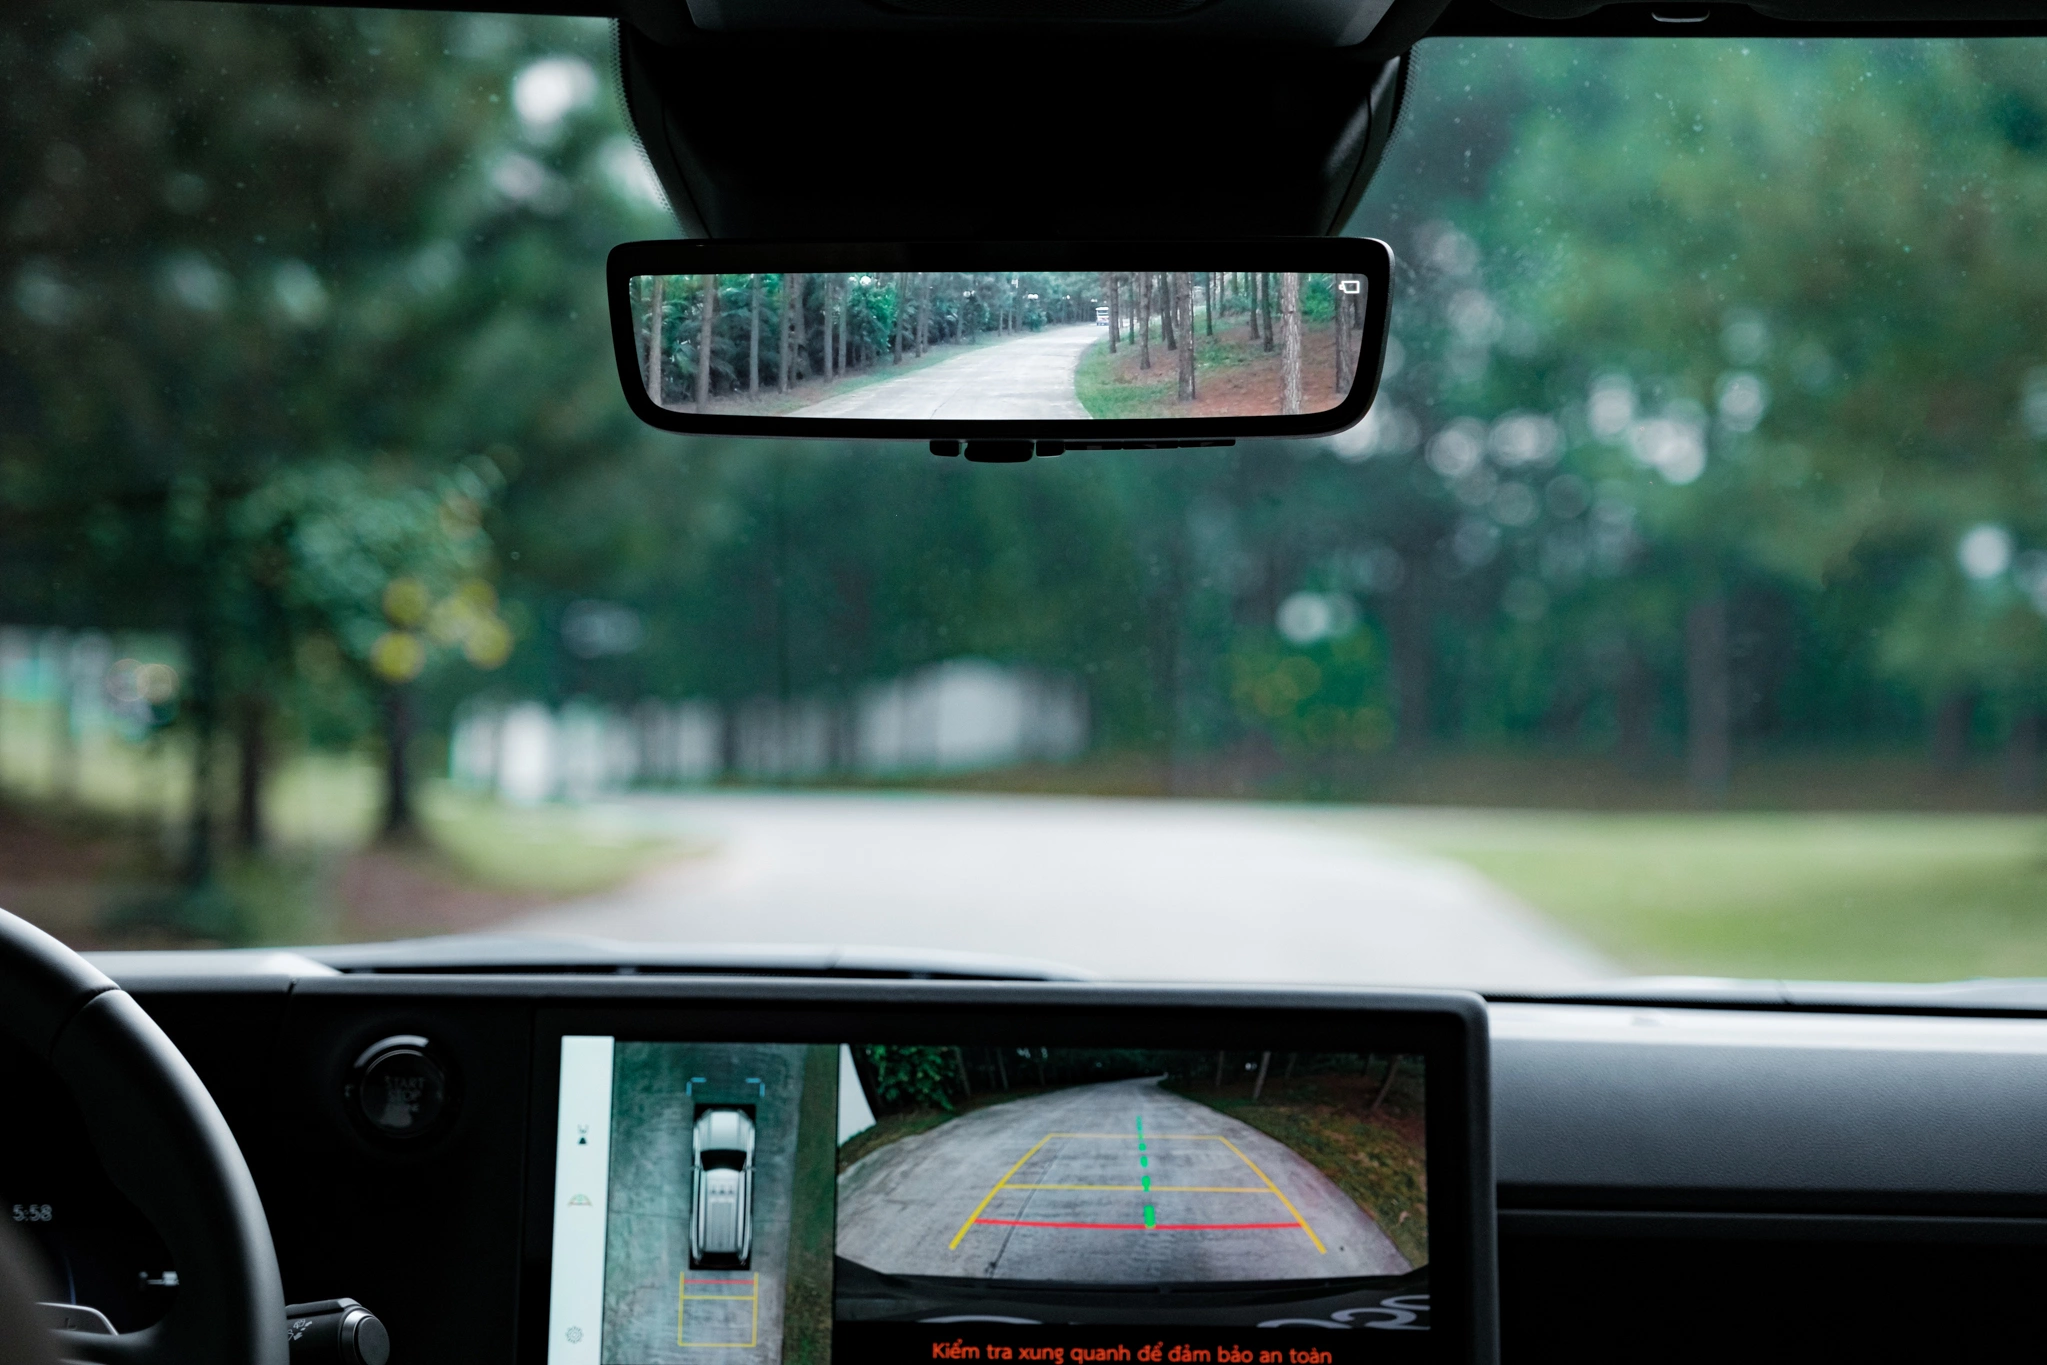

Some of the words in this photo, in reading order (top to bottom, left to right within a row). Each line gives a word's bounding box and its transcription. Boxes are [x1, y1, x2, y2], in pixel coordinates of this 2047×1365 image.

[13, 1204, 52, 1221] 5:58
[932, 1338, 981, 1360] Kiểm
[986, 1344, 1013, 1360] tra
[1018, 1347, 1065, 1365] xung
[1070, 1344, 1131, 1365] quanh
[1136, 1341, 1163, 1362] để
[1168, 1343, 1211, 1363] đảm
[1217, 1344, 1254, 1363] bảo
[1259, 1349, 1283, 1364] an
[1289, 1346, 1333, 1364] toàn
